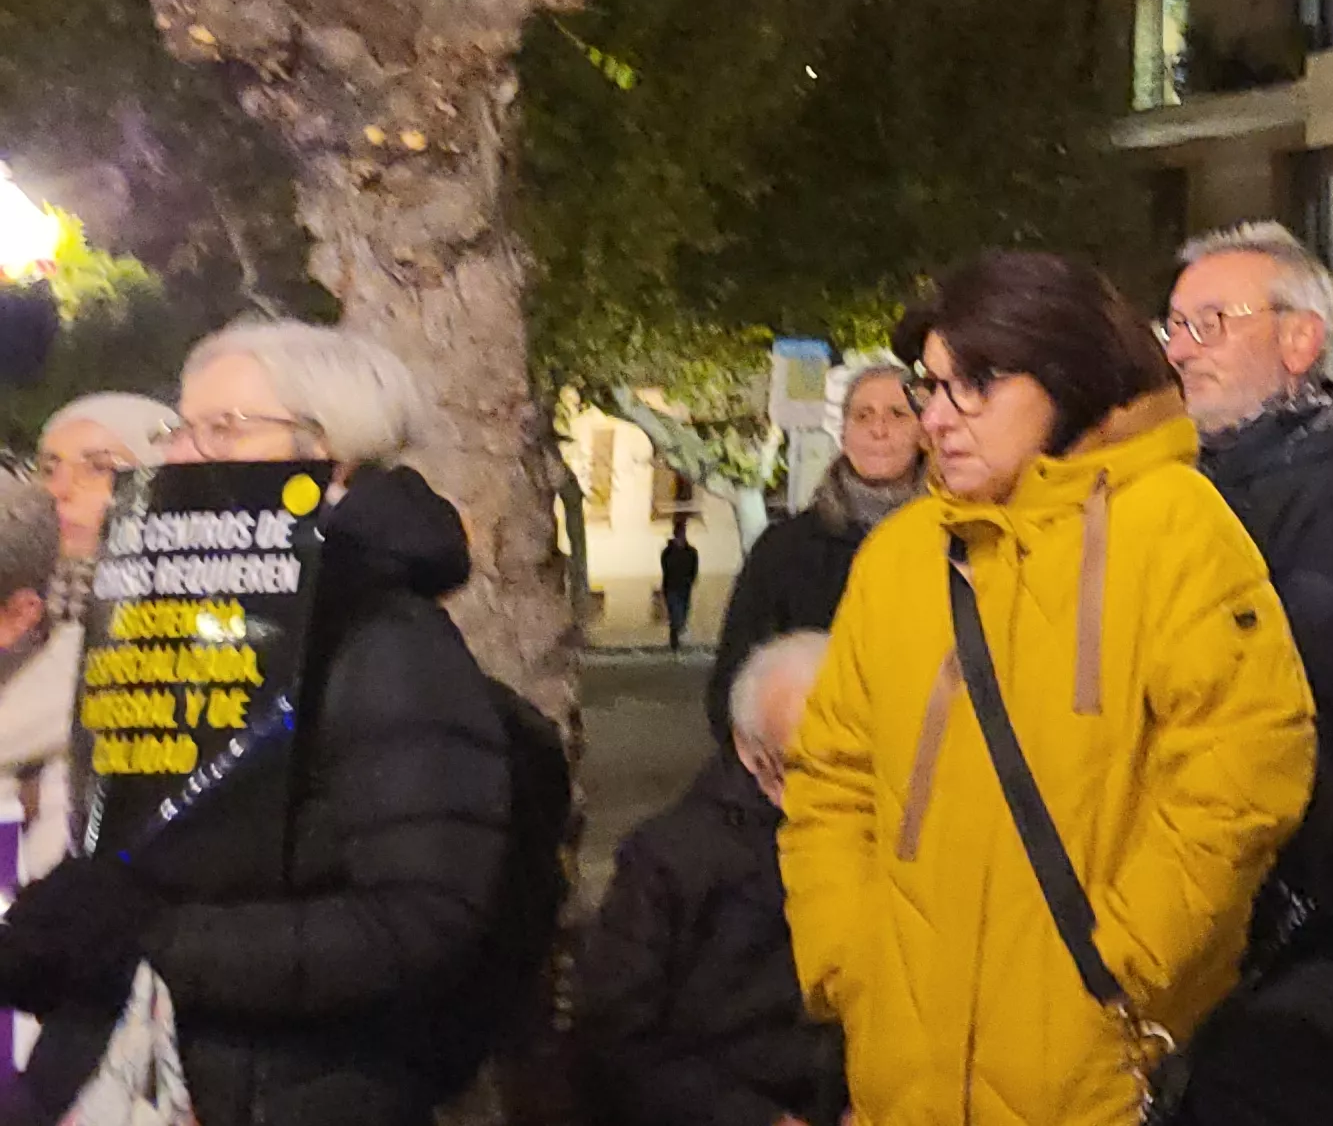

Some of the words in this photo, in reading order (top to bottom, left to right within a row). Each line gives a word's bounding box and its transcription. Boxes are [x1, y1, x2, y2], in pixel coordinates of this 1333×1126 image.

[144, 510, 256, 552] CENTROS
[255, 509, 297, 549] DE
[154, 553, 301, 595] REQUIEREN
[185, 687, 206, 728] Y
[207, 687, 251, 729] DE
